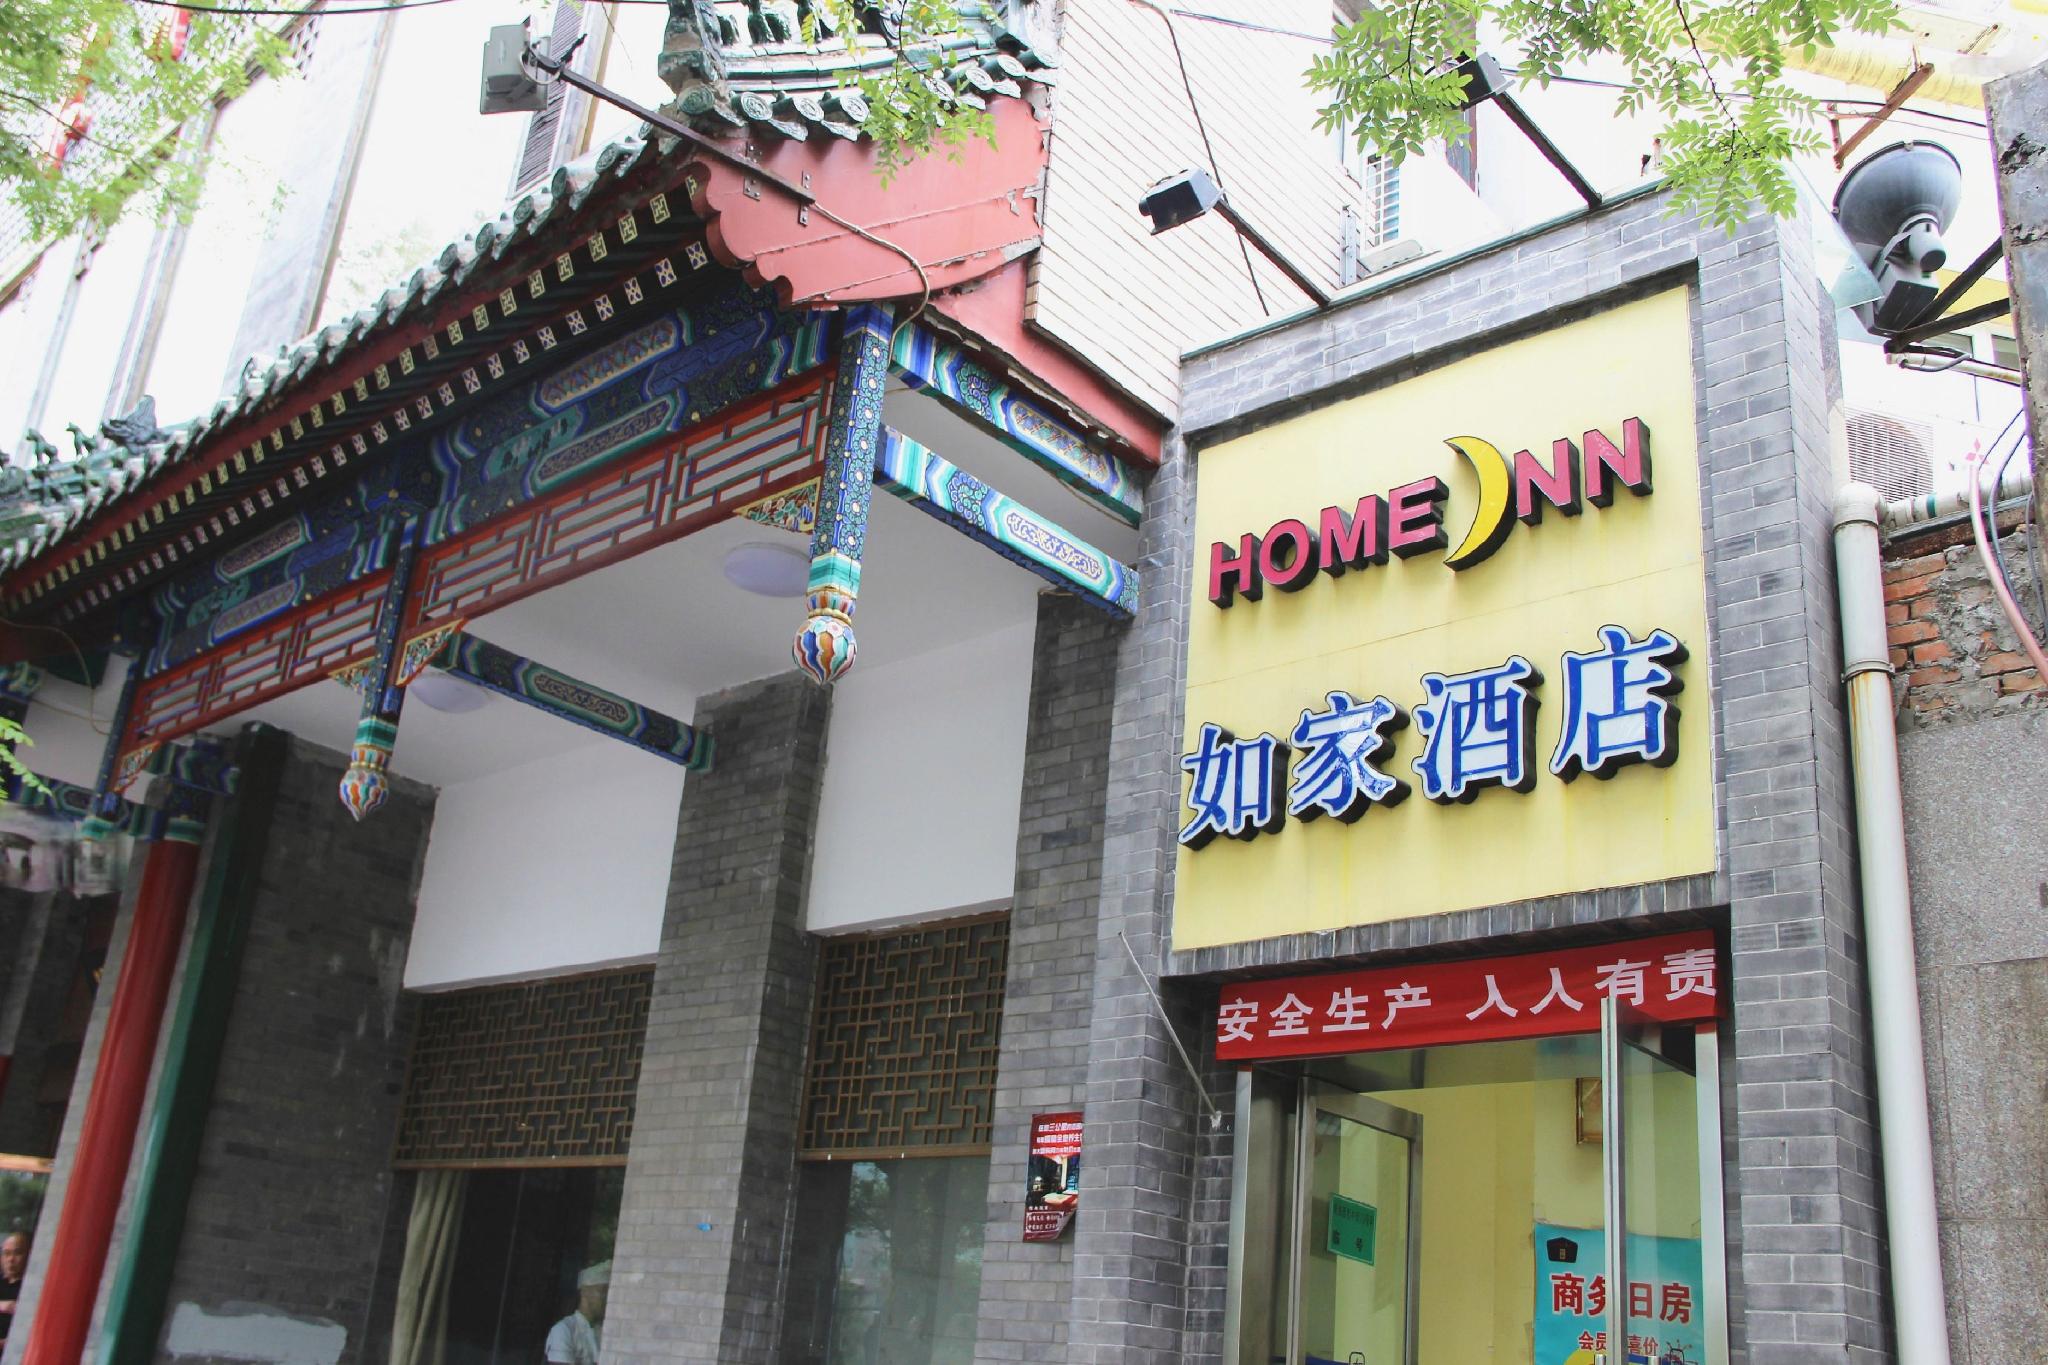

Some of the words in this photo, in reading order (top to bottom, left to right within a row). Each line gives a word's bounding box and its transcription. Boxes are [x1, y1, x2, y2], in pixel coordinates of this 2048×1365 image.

[1209, 476, 1449, 609] HOME
[1178, 624, 1689, 851] 如家酒店
[1217, 982, 1432, 1043] 安全生产
[1466, 948, 1717, 1021] 人人有责
[1578, 1330, 1659, 1356] 会员喜价
